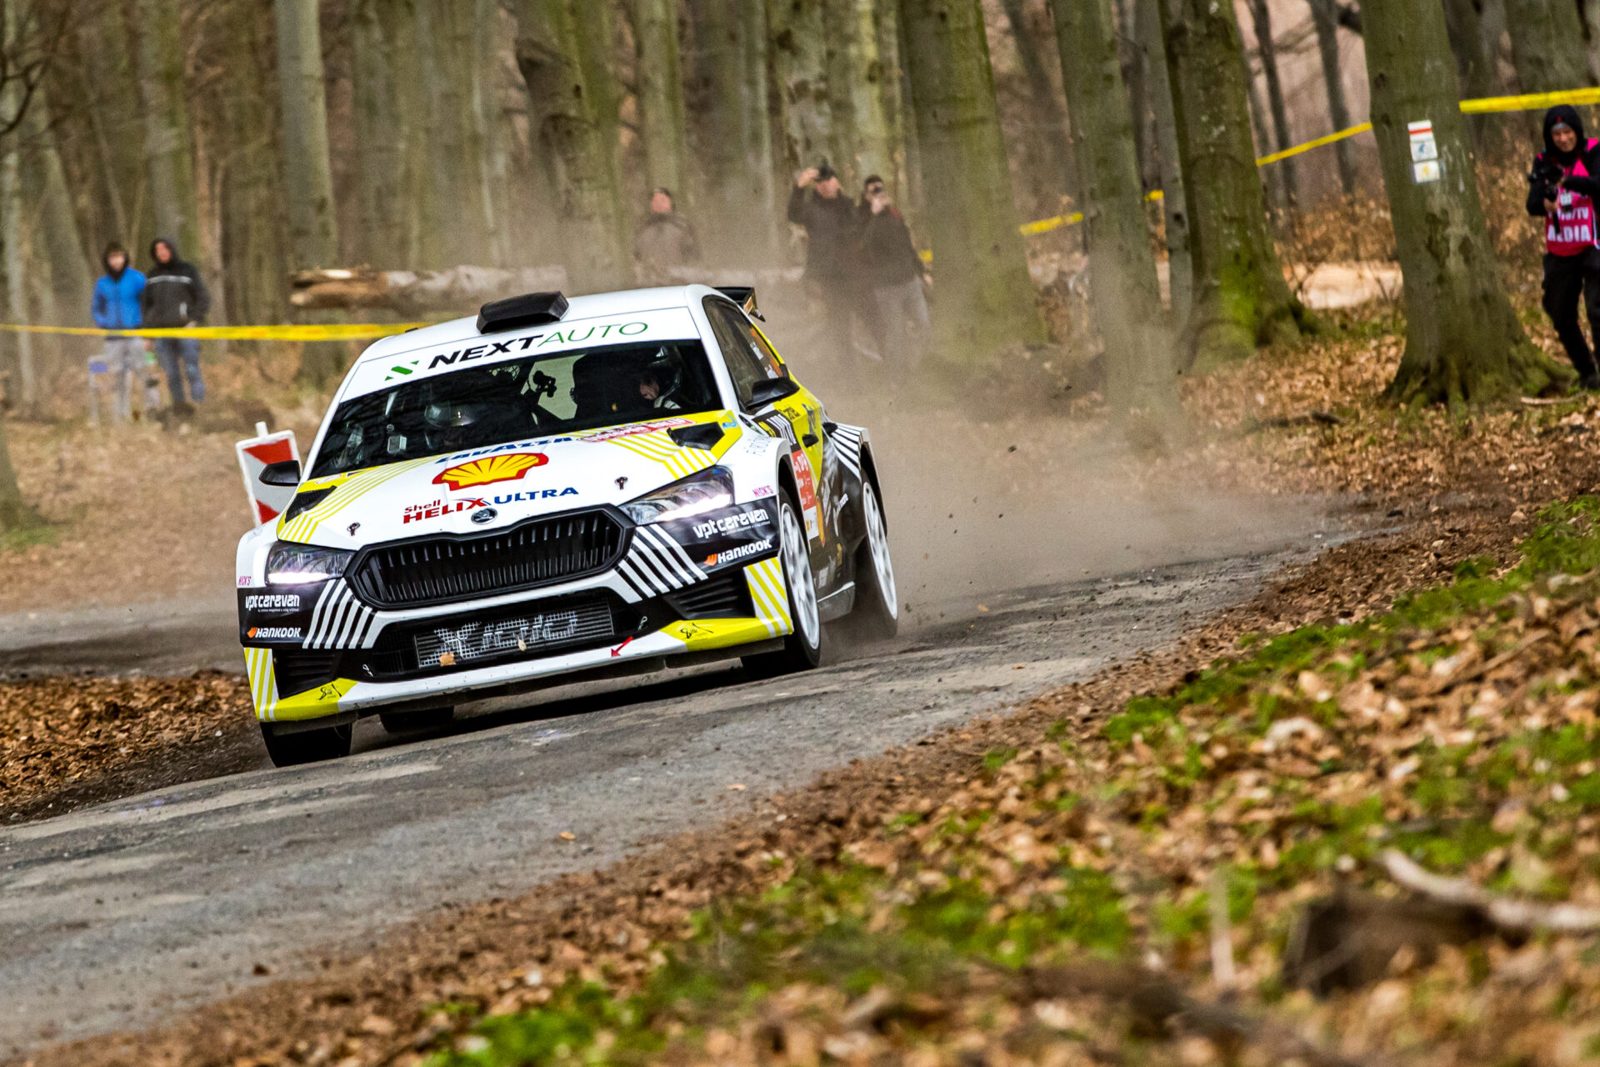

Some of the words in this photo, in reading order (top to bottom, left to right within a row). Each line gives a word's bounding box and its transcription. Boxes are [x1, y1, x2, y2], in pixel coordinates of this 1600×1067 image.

[428, 322, 648, 369] NEXTAUTO
[403, 499, 487, 524] HELIX
[494, 487, 579, 504] ULTRA
[404, 499, 441, 513] Shell
